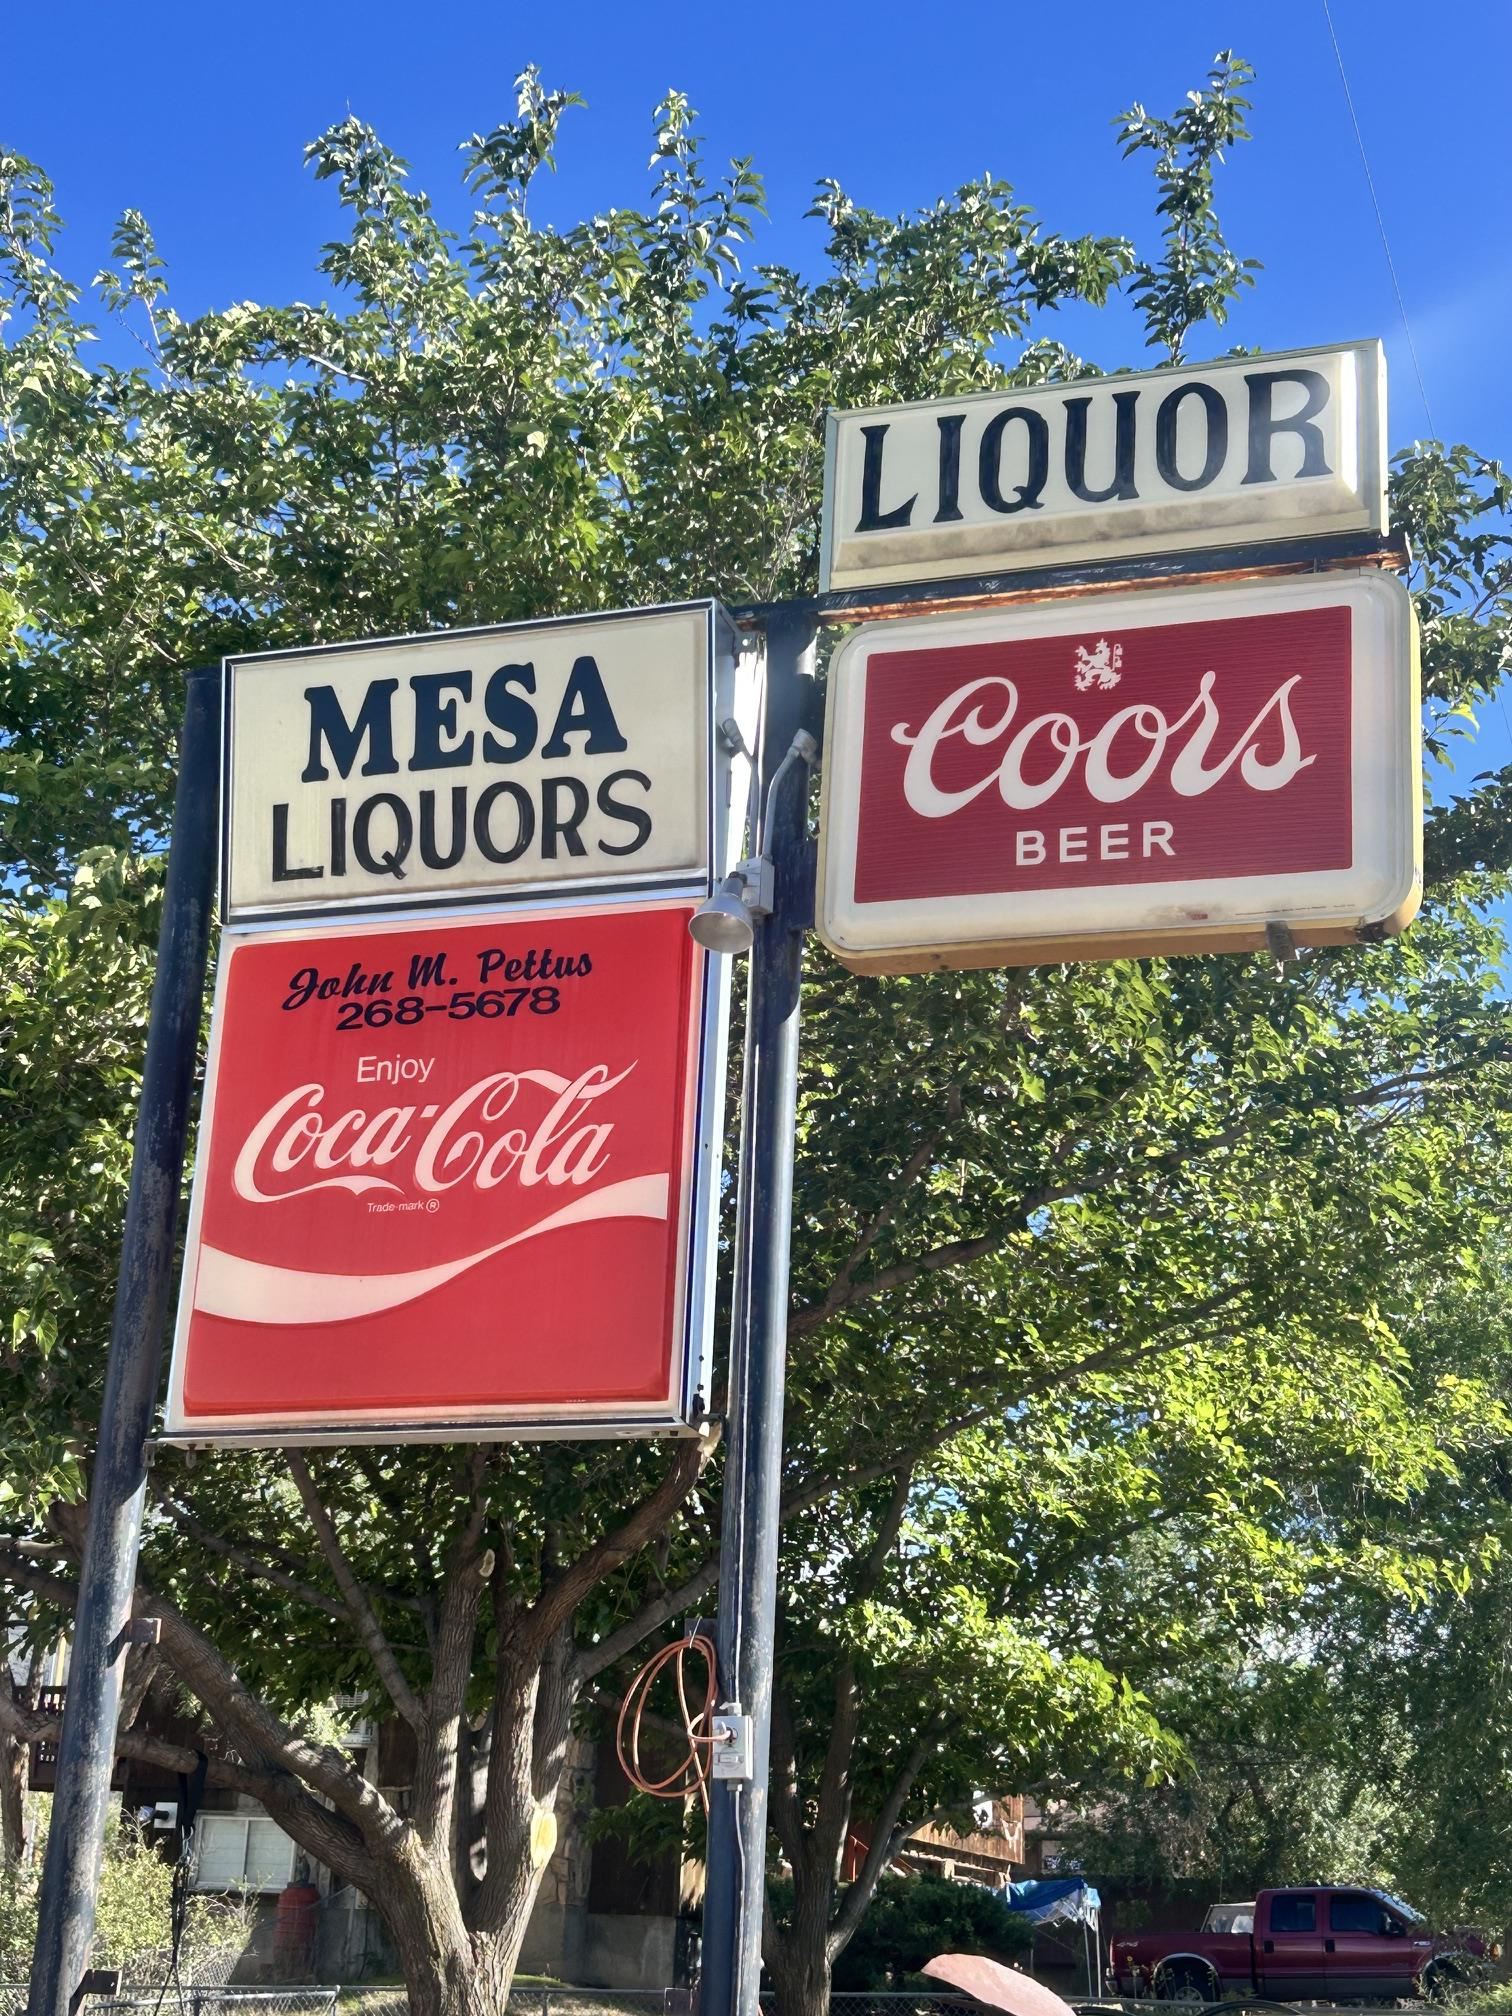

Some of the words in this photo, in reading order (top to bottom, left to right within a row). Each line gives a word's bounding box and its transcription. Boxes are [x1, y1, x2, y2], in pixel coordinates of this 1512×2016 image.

[855, 369, 1333, 532] LIQUOR
[301, 656, 628, 783] MESA
[891, 671, 1317, 818] Coors
[272, 769, 652, 882] LIQUORS
[1015, 820, 1176, 866] BEER
[282, 962, 392, 1010] John
[409, 952, 458, 989] M.
[479, 948, 592, 982] Pettus
[336, 986, 561, 1031] 268-5678
[357, 1055, 435, 1084] Enjoy
[232, 1058, 639, 1202] Coca-Cola
